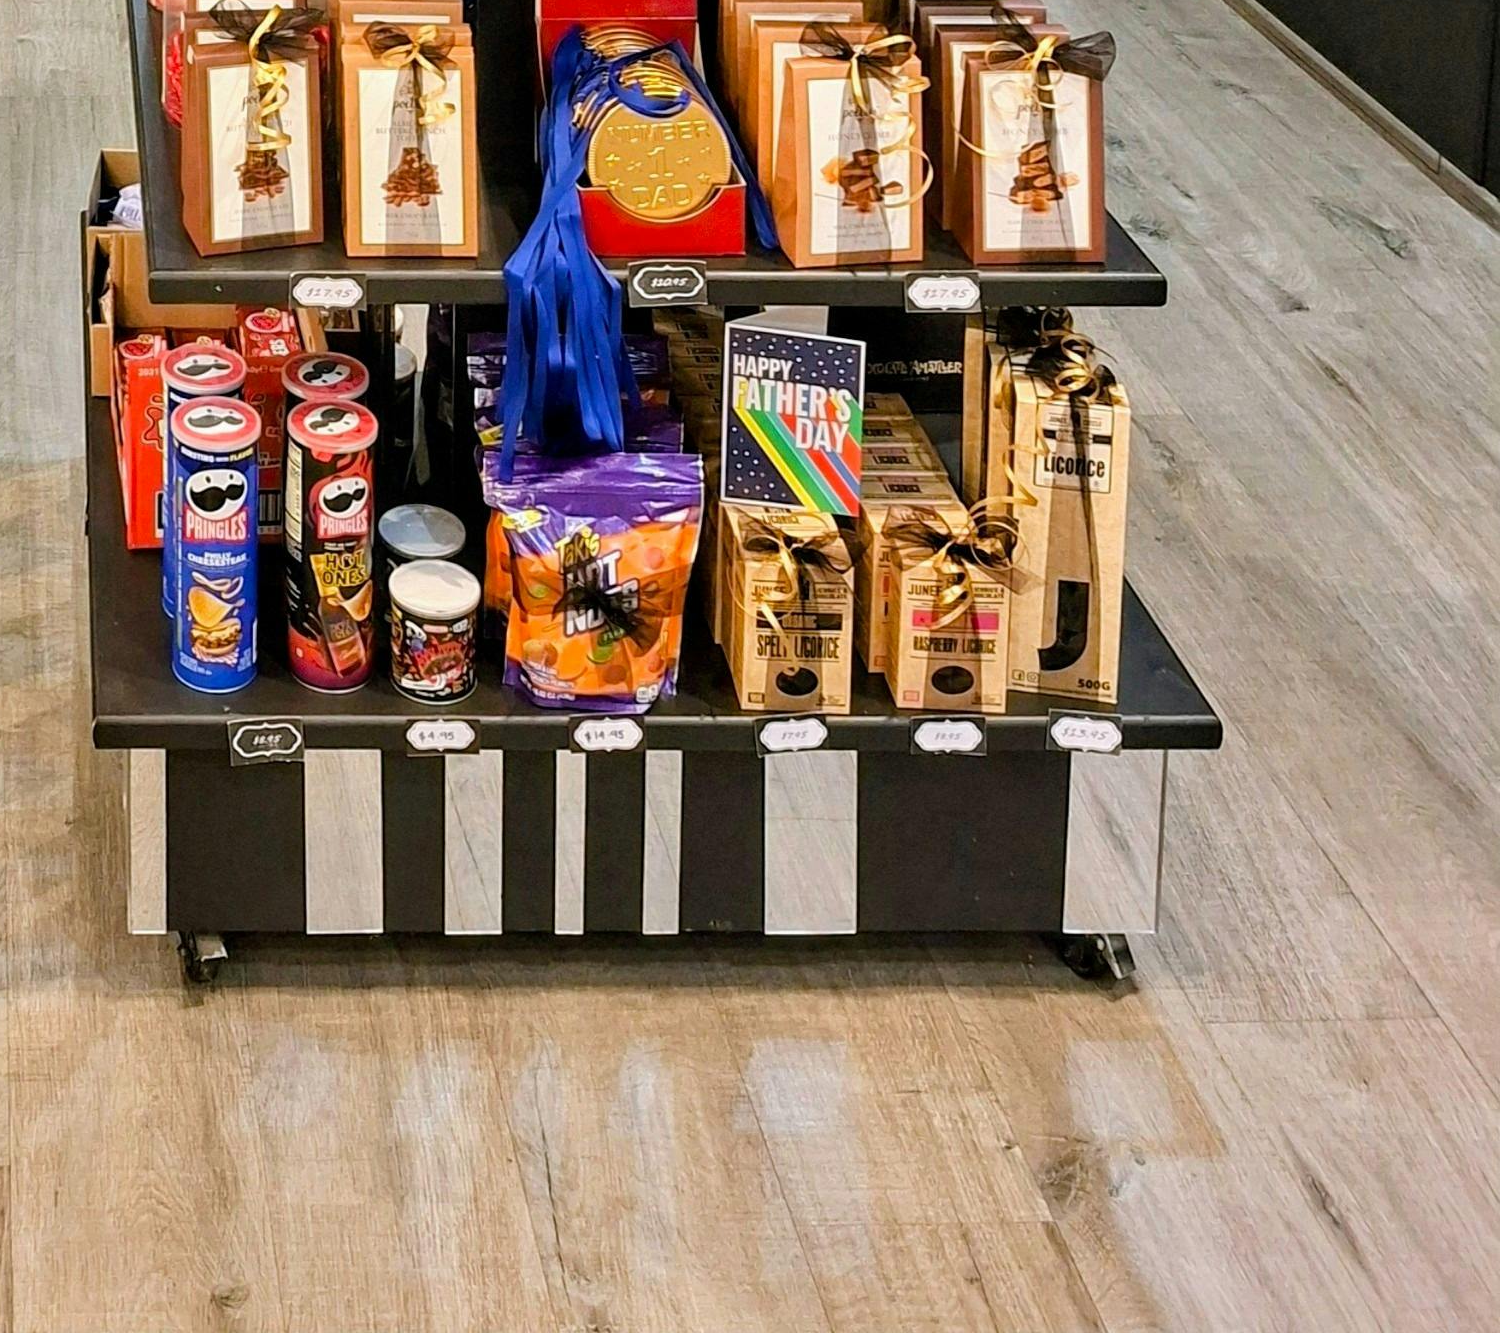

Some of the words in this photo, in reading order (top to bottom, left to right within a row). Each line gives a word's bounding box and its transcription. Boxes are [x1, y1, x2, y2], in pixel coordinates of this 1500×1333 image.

[607, 120, 711, 143] NUMBER
[647, 146, 675, 178] 1
[632, 184, 694, 208] DAD
[733, 353, 794, 381] HAPPY
[732, 376, 852, 421] FATHER'S
[795, 417, 849, 454] DAY
[186, 507, 247, 541] PRINGLES
[317, 512, 368, 537] PRINGLES
[205, 551, 231, 559] PHILLY
[554, 525, 600, 565] Takis
[187, 553, 247, 566] CHEESESTEAK
[324, 552, 365, 570] HOT
[322, 569, 367, 586] ONES
[795, 636, 840, 658] LICORICE
[913, 636, 958, 650] RASPBERRY
[961, 637, 996, 654] LICORICE
[1077, 678, 1111, 692] 500G
[419, 731, 454, 741] $4.95
